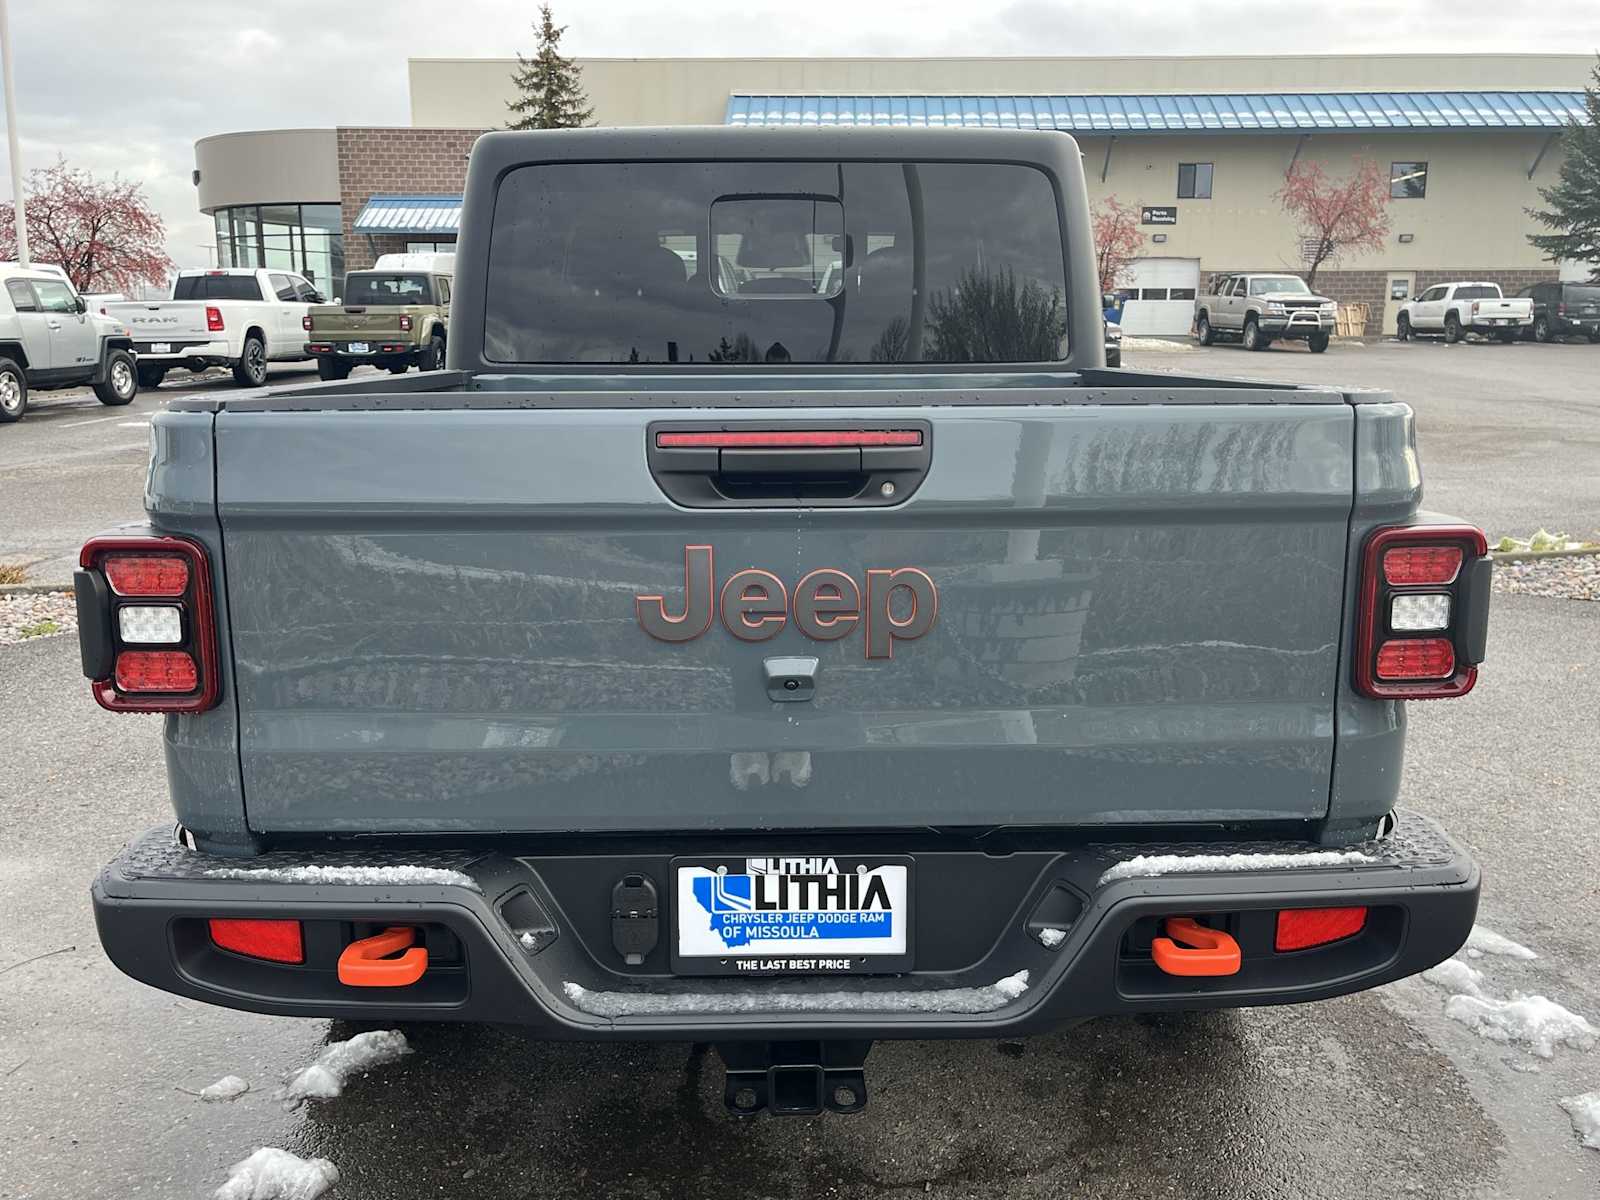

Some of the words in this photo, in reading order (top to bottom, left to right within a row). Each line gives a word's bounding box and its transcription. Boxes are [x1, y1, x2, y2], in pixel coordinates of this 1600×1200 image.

[636, 544, 938, 659] Jeep
[767, 858, 839, 874] LITHIA
[755, 875, 892, 910] LITHIA
[722, 914, 783, 924] CHRYSLER
[786, 914, 814, 924] JEEP
[818, 914, 856, 923] DODGE
[859, 913, 885, 922] RAM
[722, 926, 741, 938] OF
[746, 926, 819, 938] MISSOULA
[736, 960, 758, 970] THE
[760, 960, 787, 970] LAST
[789, 960, 817, 970] BEST
[819, 959, 851, 969] PRICE
